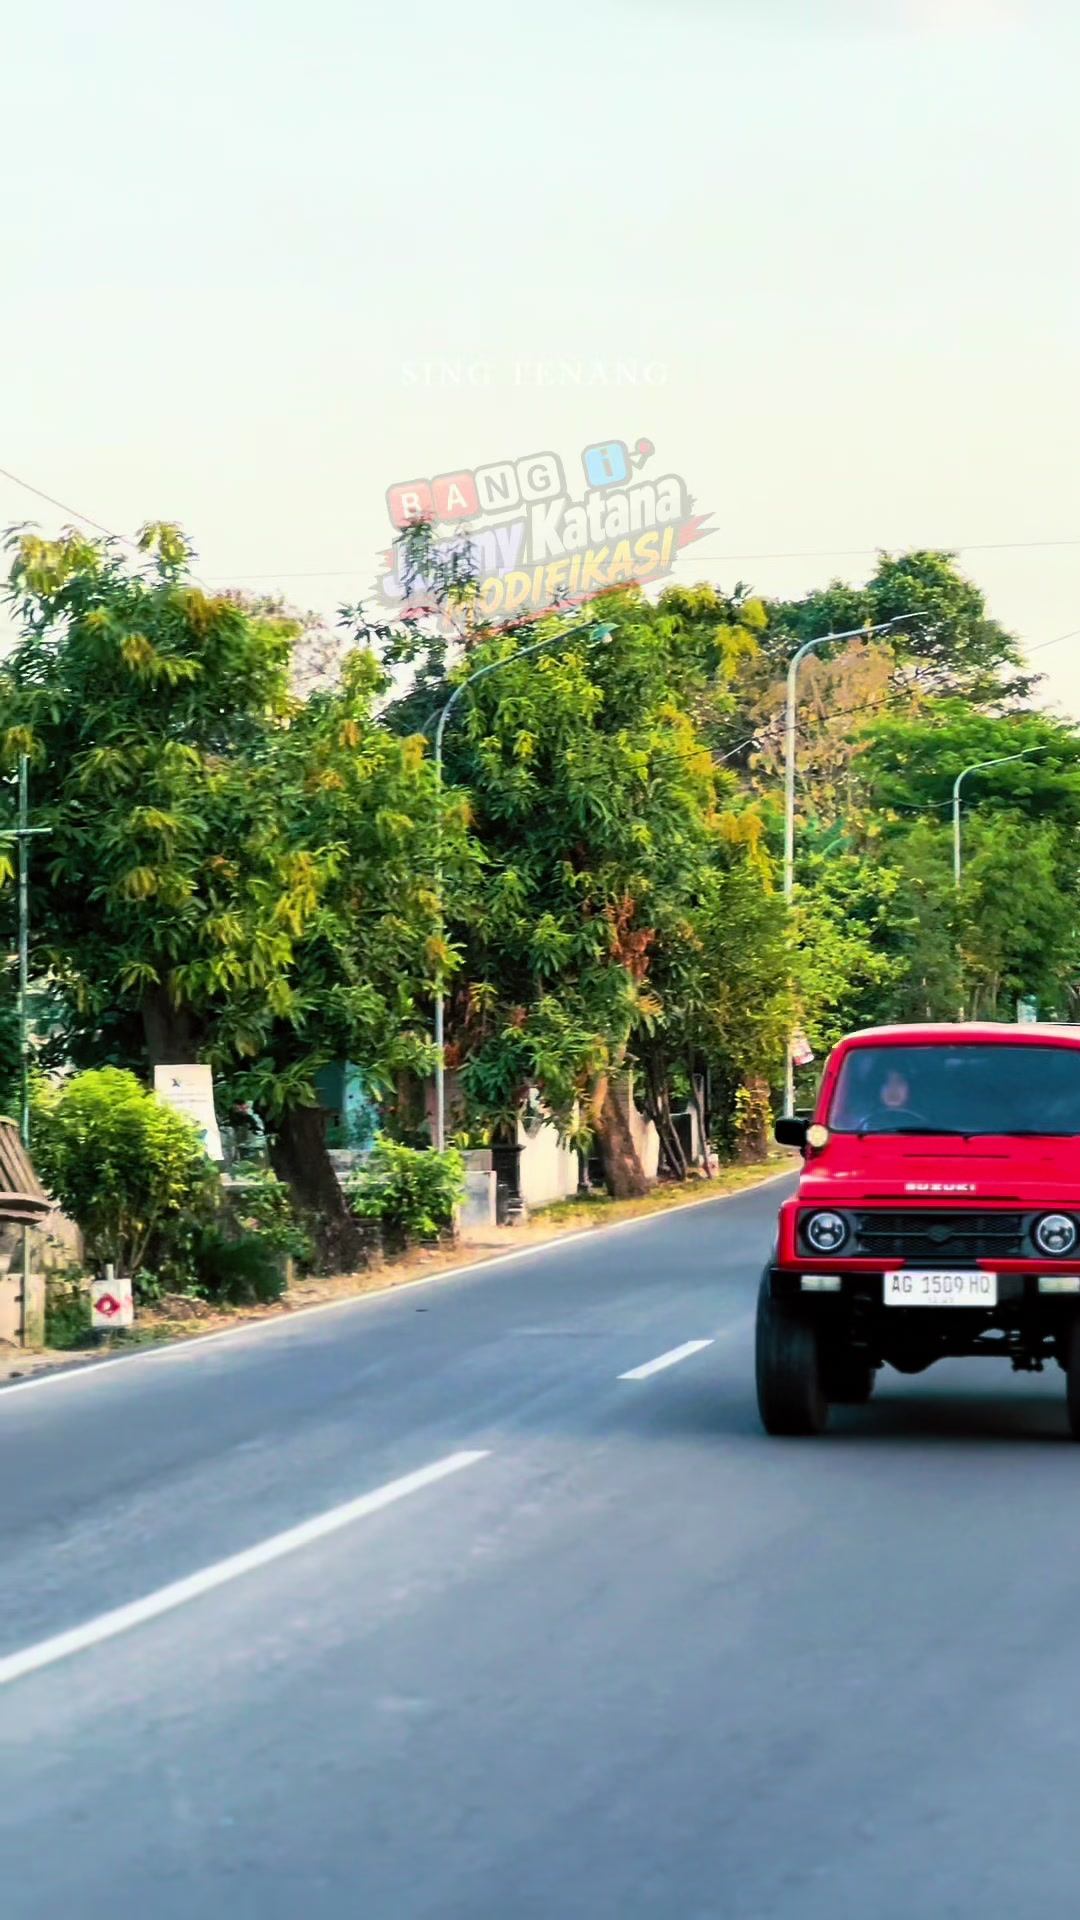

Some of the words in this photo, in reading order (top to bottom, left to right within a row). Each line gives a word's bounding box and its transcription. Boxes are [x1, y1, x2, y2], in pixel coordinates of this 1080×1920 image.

[905, 1183, 976, 1192] SUZUKI
[891, 1275, 913, 1293] AG
[921, 1275, 964, 1294] 1509
